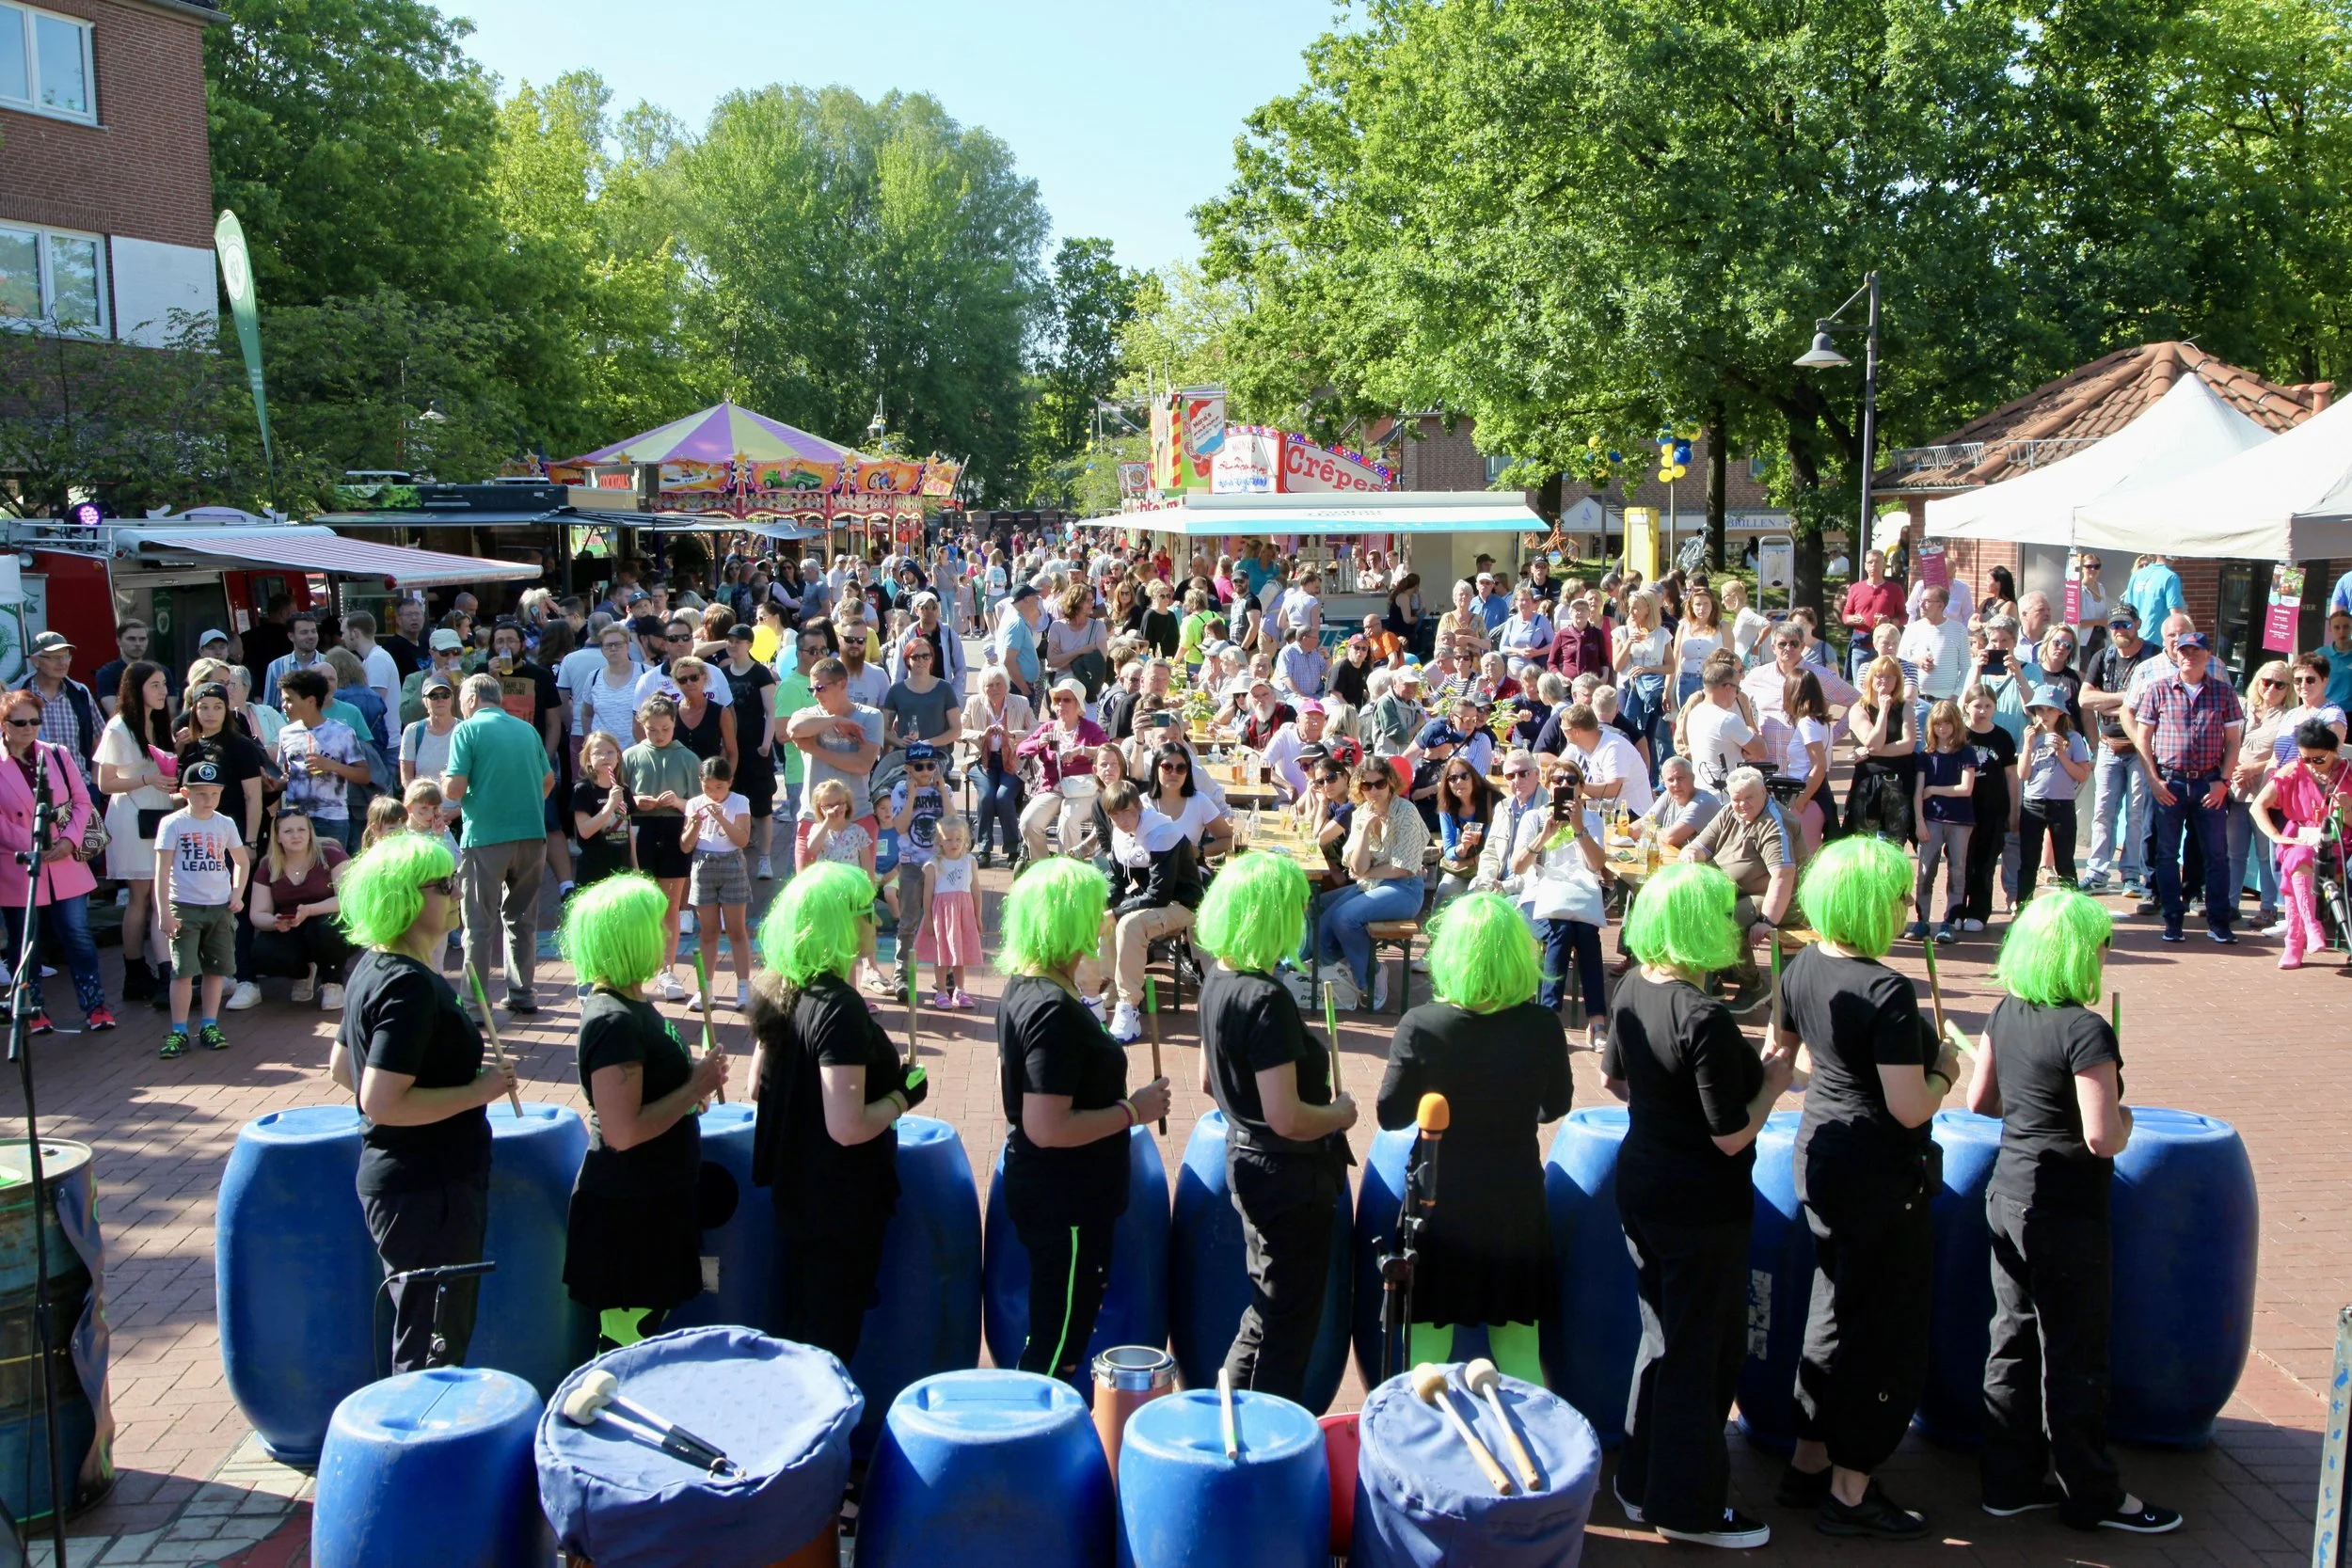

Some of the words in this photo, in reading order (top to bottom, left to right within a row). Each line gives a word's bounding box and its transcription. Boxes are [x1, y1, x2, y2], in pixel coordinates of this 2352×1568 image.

[1285, 445, 1384, 492] Crêpes
[599, 474, 629, 489] COCKTAILS
[909, 748, 933, 756] Surfing
